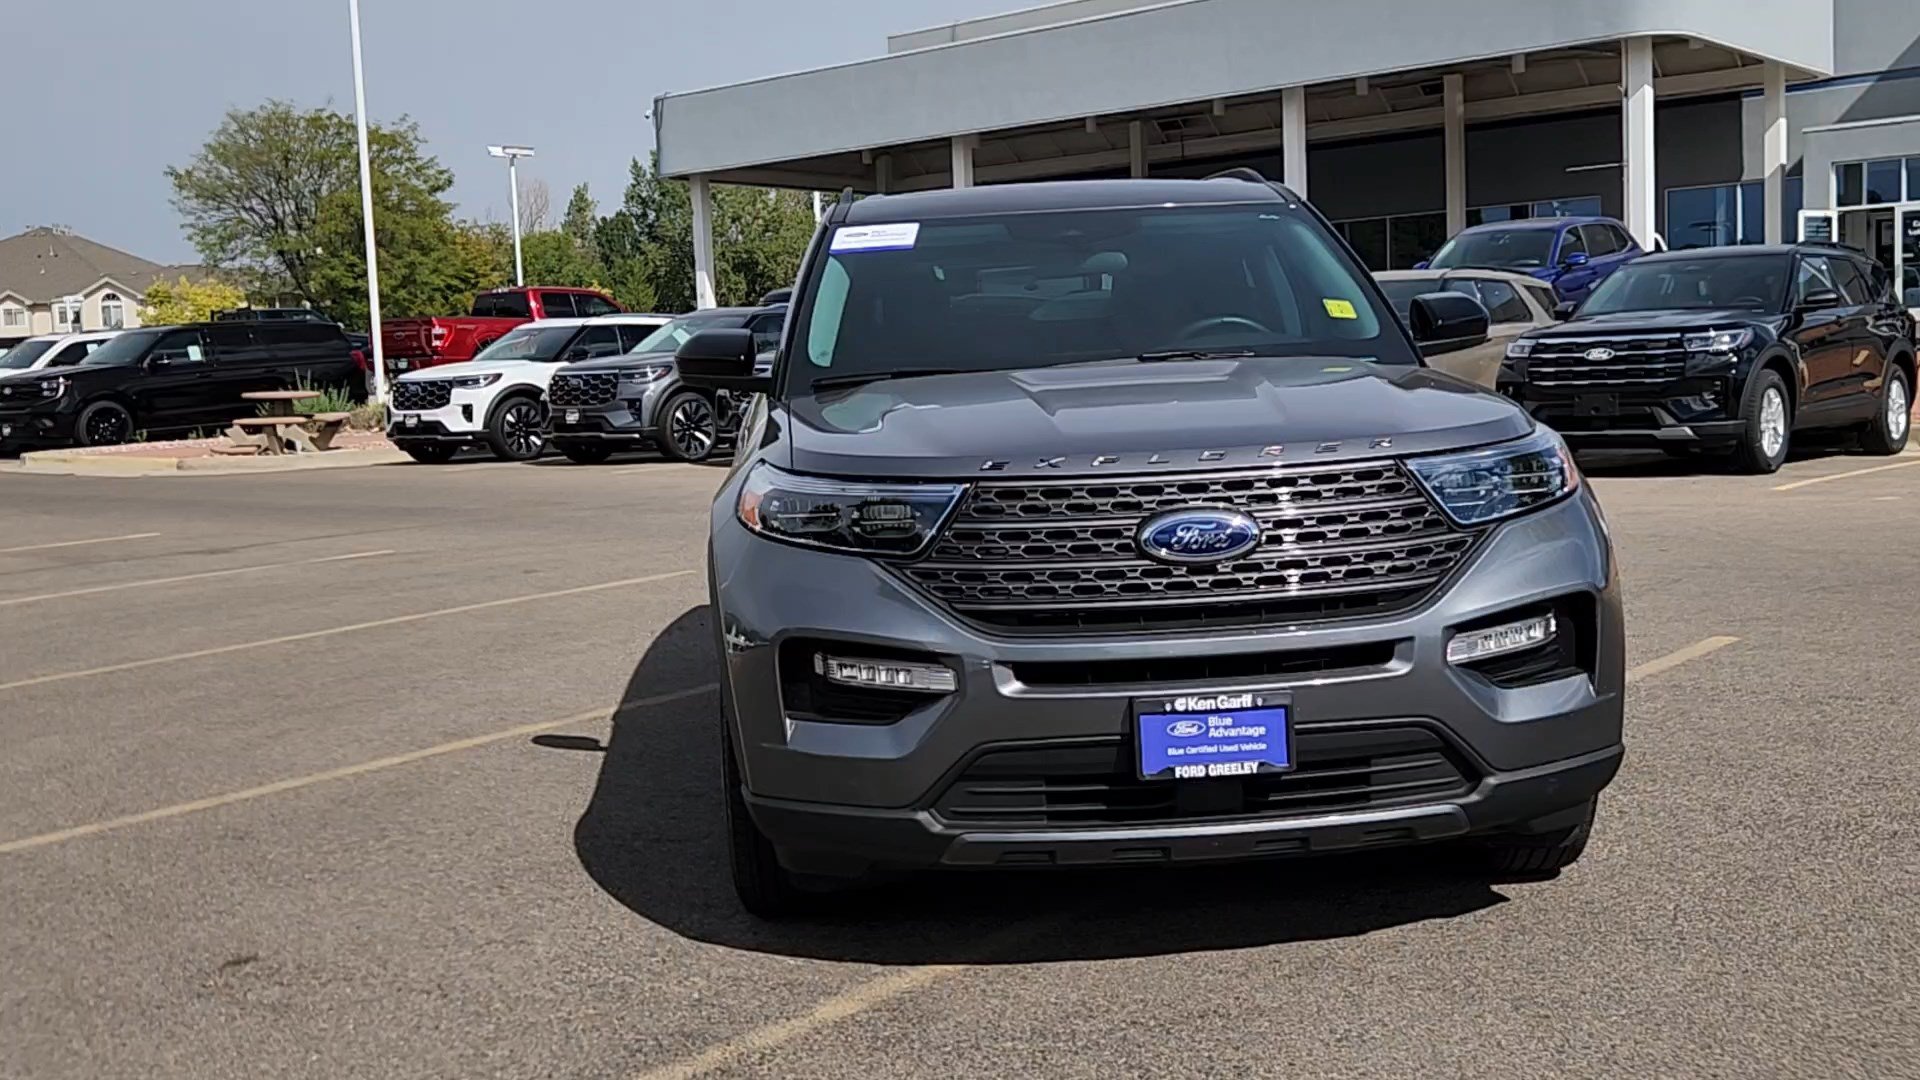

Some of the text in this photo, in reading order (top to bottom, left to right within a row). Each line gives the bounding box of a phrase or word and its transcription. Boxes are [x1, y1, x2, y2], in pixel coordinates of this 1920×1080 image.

[979, 436, 1393, 471] EXPLORER
[1170, 522, 1233, 551] Ford
[1187, 693, 1253, 711] Ken Garff
[1173, 722, 1200, 736] Ford
[1208, 716, 1233, 727] Blue
[1208, 725, 1267, 738] Advantage
[1167, 742, 1267, 756] Blue Certified Used Vehicle
[1174, 762, 1259, 779] FORD GREELEY
